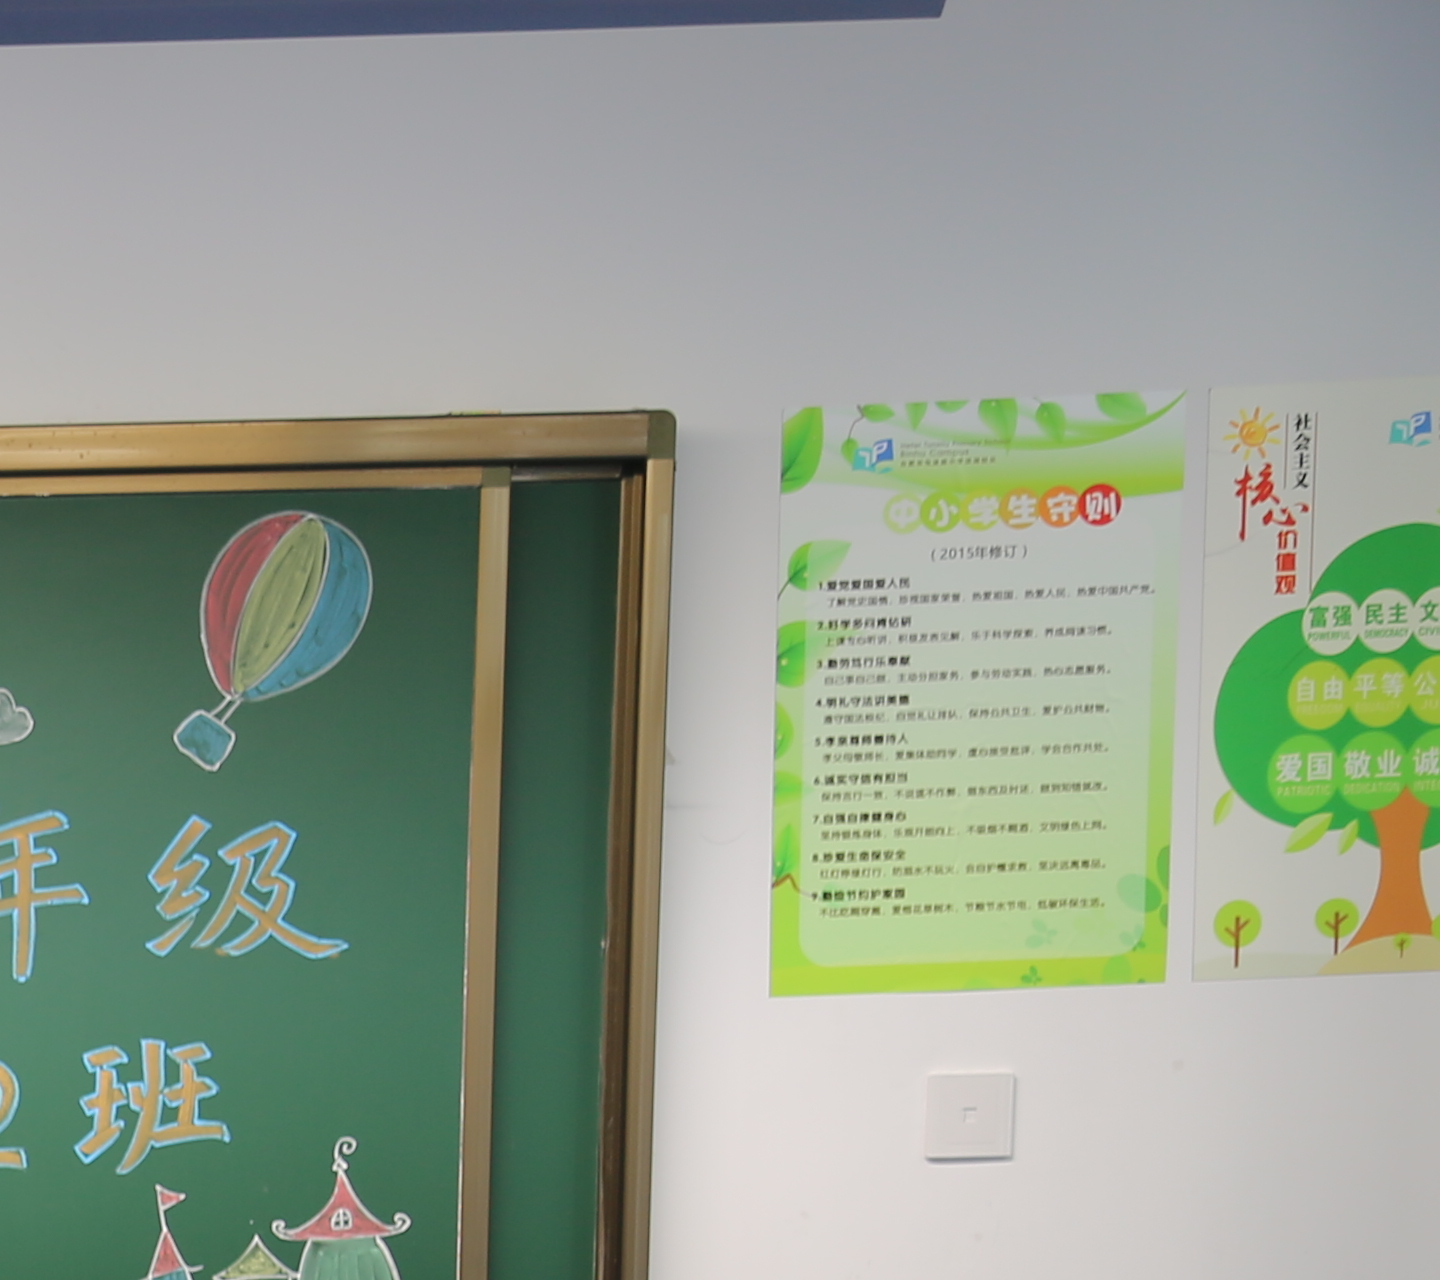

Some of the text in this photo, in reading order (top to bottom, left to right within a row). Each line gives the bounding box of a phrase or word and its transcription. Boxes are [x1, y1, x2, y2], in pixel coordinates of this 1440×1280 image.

[1292, 412, 1311, 490] 社会主义
[888, 490, 1117, 527] 中小学生守则
[1309, 604, 1353, 629] 富强
[1365, 602, 1408, 626] 民主
[1297, 676, 1344, 702] 自由
[1354, 672, 1405, 699] 平等
[1276, 752, 1333, 783] 爱国
[1344, 749, 1401, 780] 敬业
